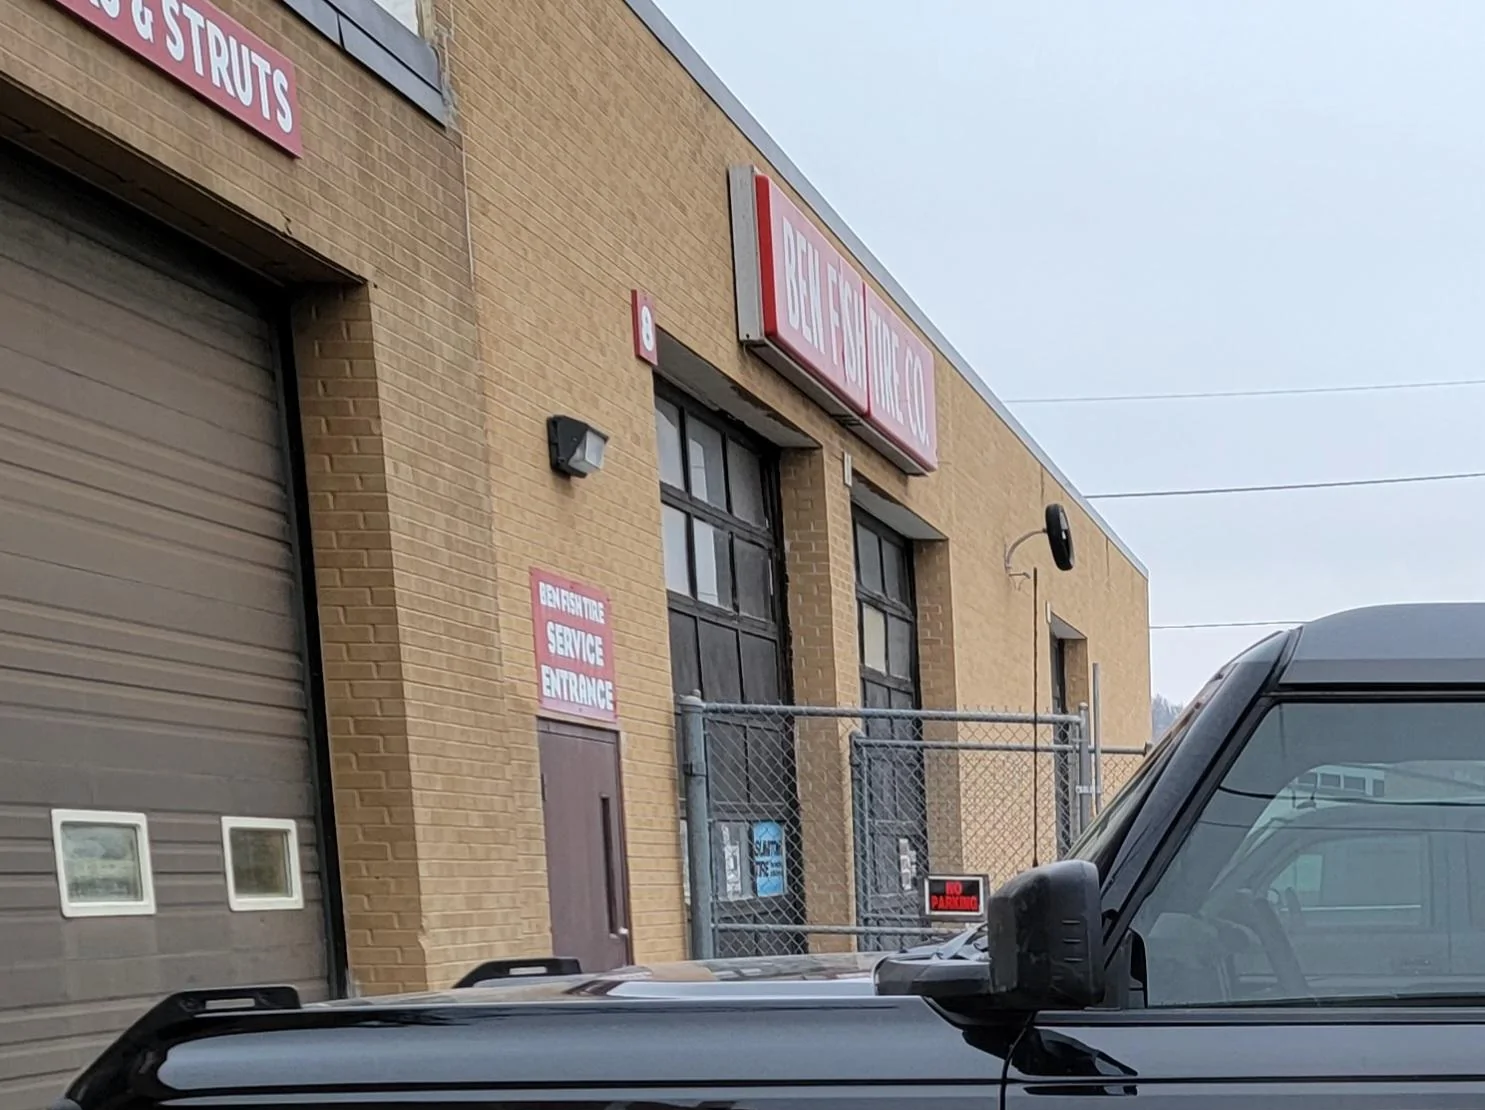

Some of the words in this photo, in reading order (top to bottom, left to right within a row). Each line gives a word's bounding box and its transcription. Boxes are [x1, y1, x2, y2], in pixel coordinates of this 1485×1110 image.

[162, 0, 293, 134] STRUTS
[782, 216, 825, 355] BEN
[869, 307, 905, 426] TIRE
[539, 581, 561, 609] BEN
[561, 589, 582, 617] FISH
[582, 596, 606, 624] TIRE
[547, 620, 604, 667] SERVICE
[541, 664, 615, 711] ENTRANCE
[931, 895, 978, 910] PARKING
[946, 880, 963, 895] NO
